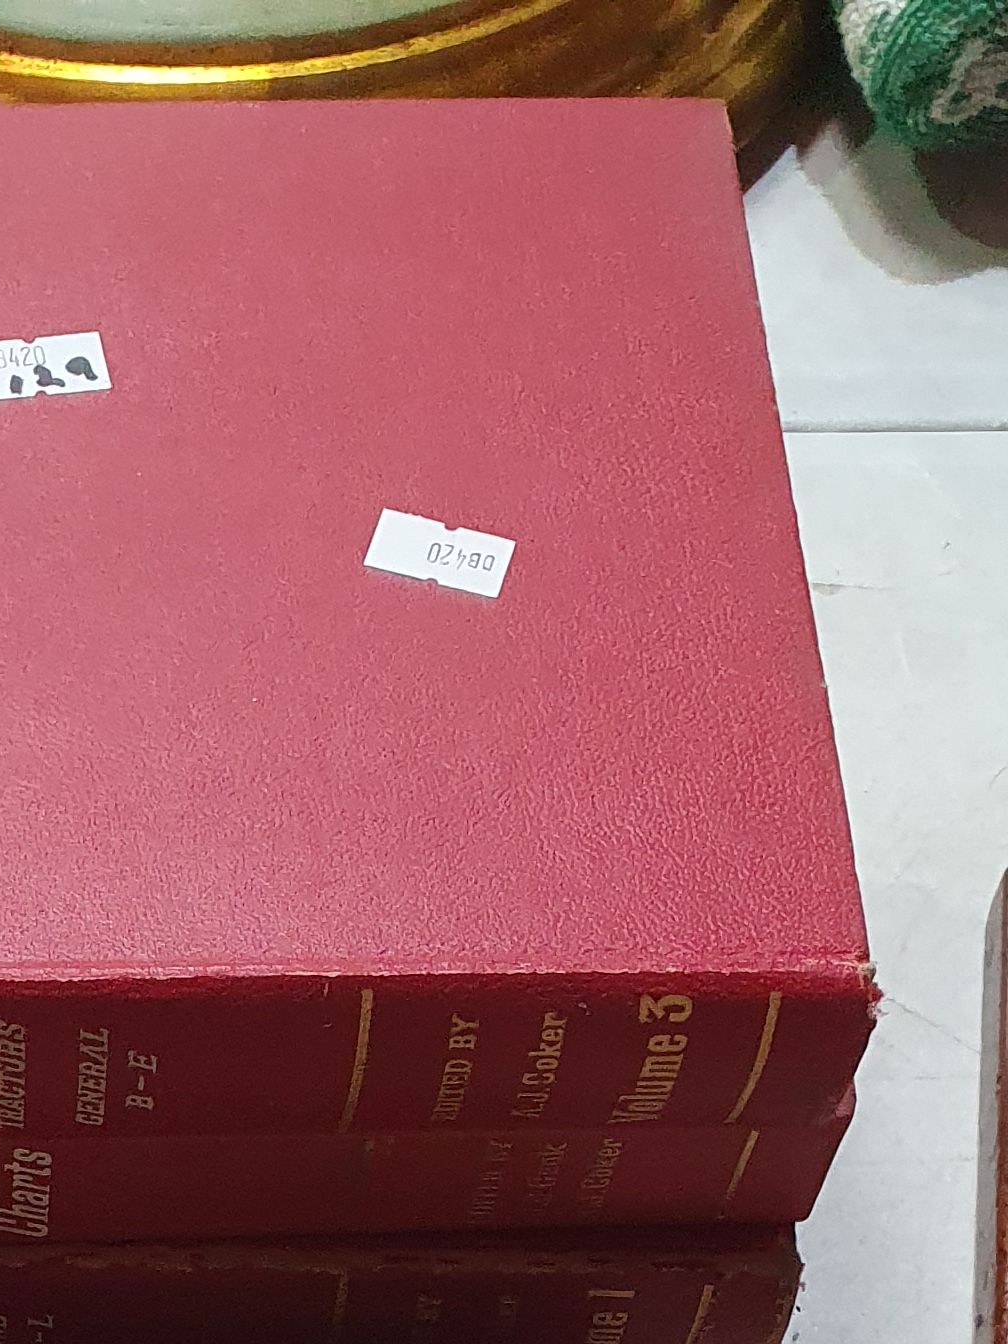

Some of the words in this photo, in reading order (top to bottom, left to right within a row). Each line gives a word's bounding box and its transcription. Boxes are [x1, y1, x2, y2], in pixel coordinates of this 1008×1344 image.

[427, 542, 495, 571] DB420
[450, 1012, 481, 1051] BY
[638, 993, 694, 1025] 3
[75, 1027, 110, 1126] GENERAL
[431, 1058, 473, 1123] EDITED
[609, 1032, 689, 1125] Volume
